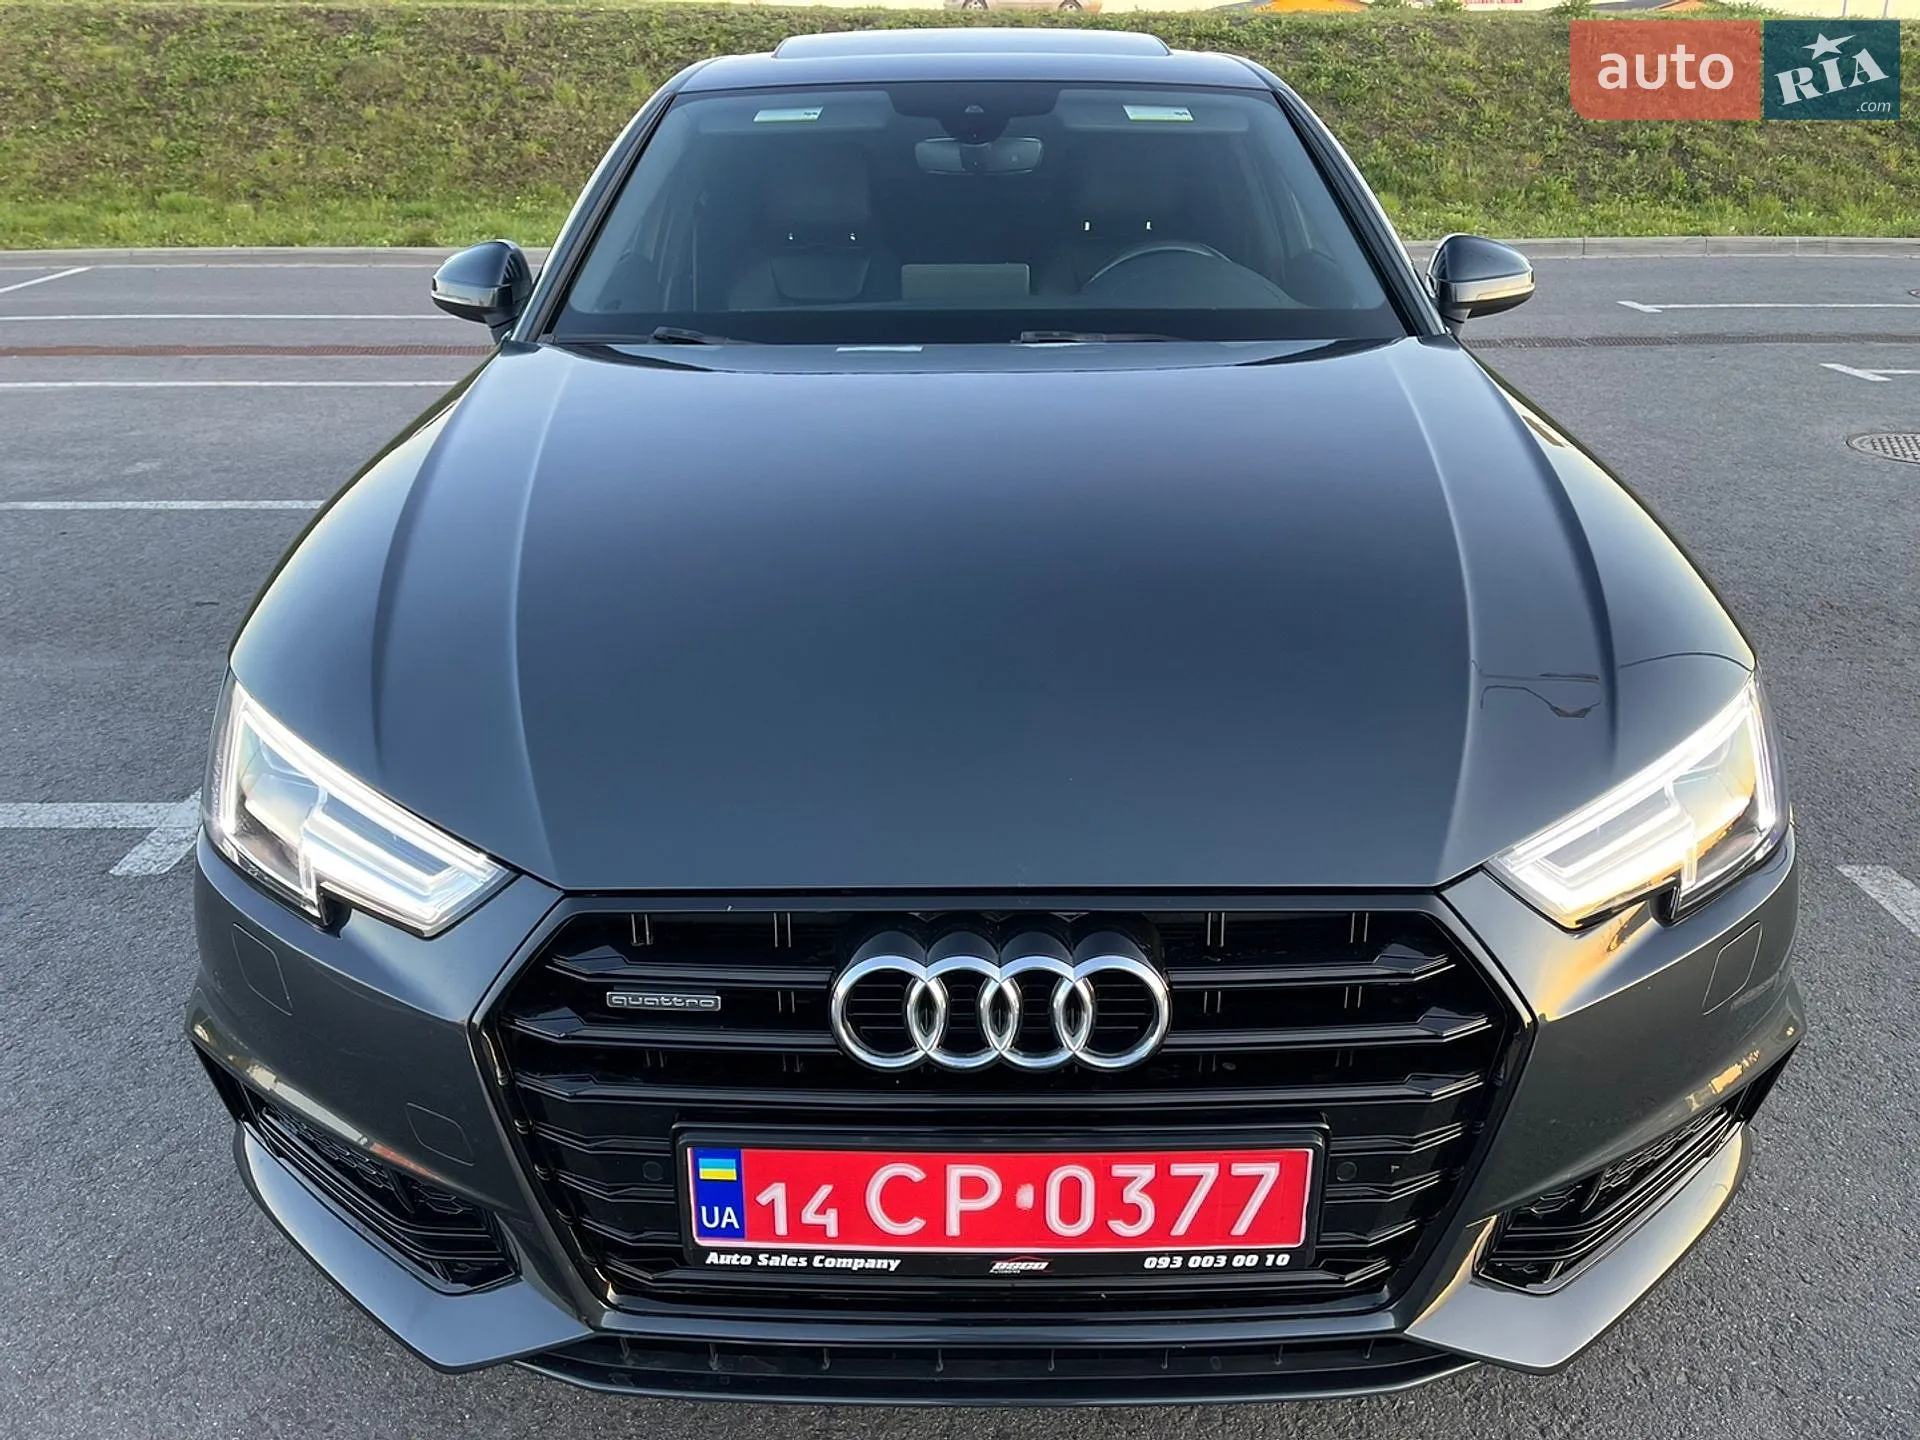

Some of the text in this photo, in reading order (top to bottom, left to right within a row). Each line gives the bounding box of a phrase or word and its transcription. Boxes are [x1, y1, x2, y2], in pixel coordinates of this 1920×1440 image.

[611, 995, 715, 1007] quattro
[755, 1162, 1281, 1239] 14 CP 0377
[701, 1205, 740, 1229] UA
[705, 1251, 901, 1271] Auto Sales Company
[1143, 1252, 1291, 1269] 093 003 00 10
